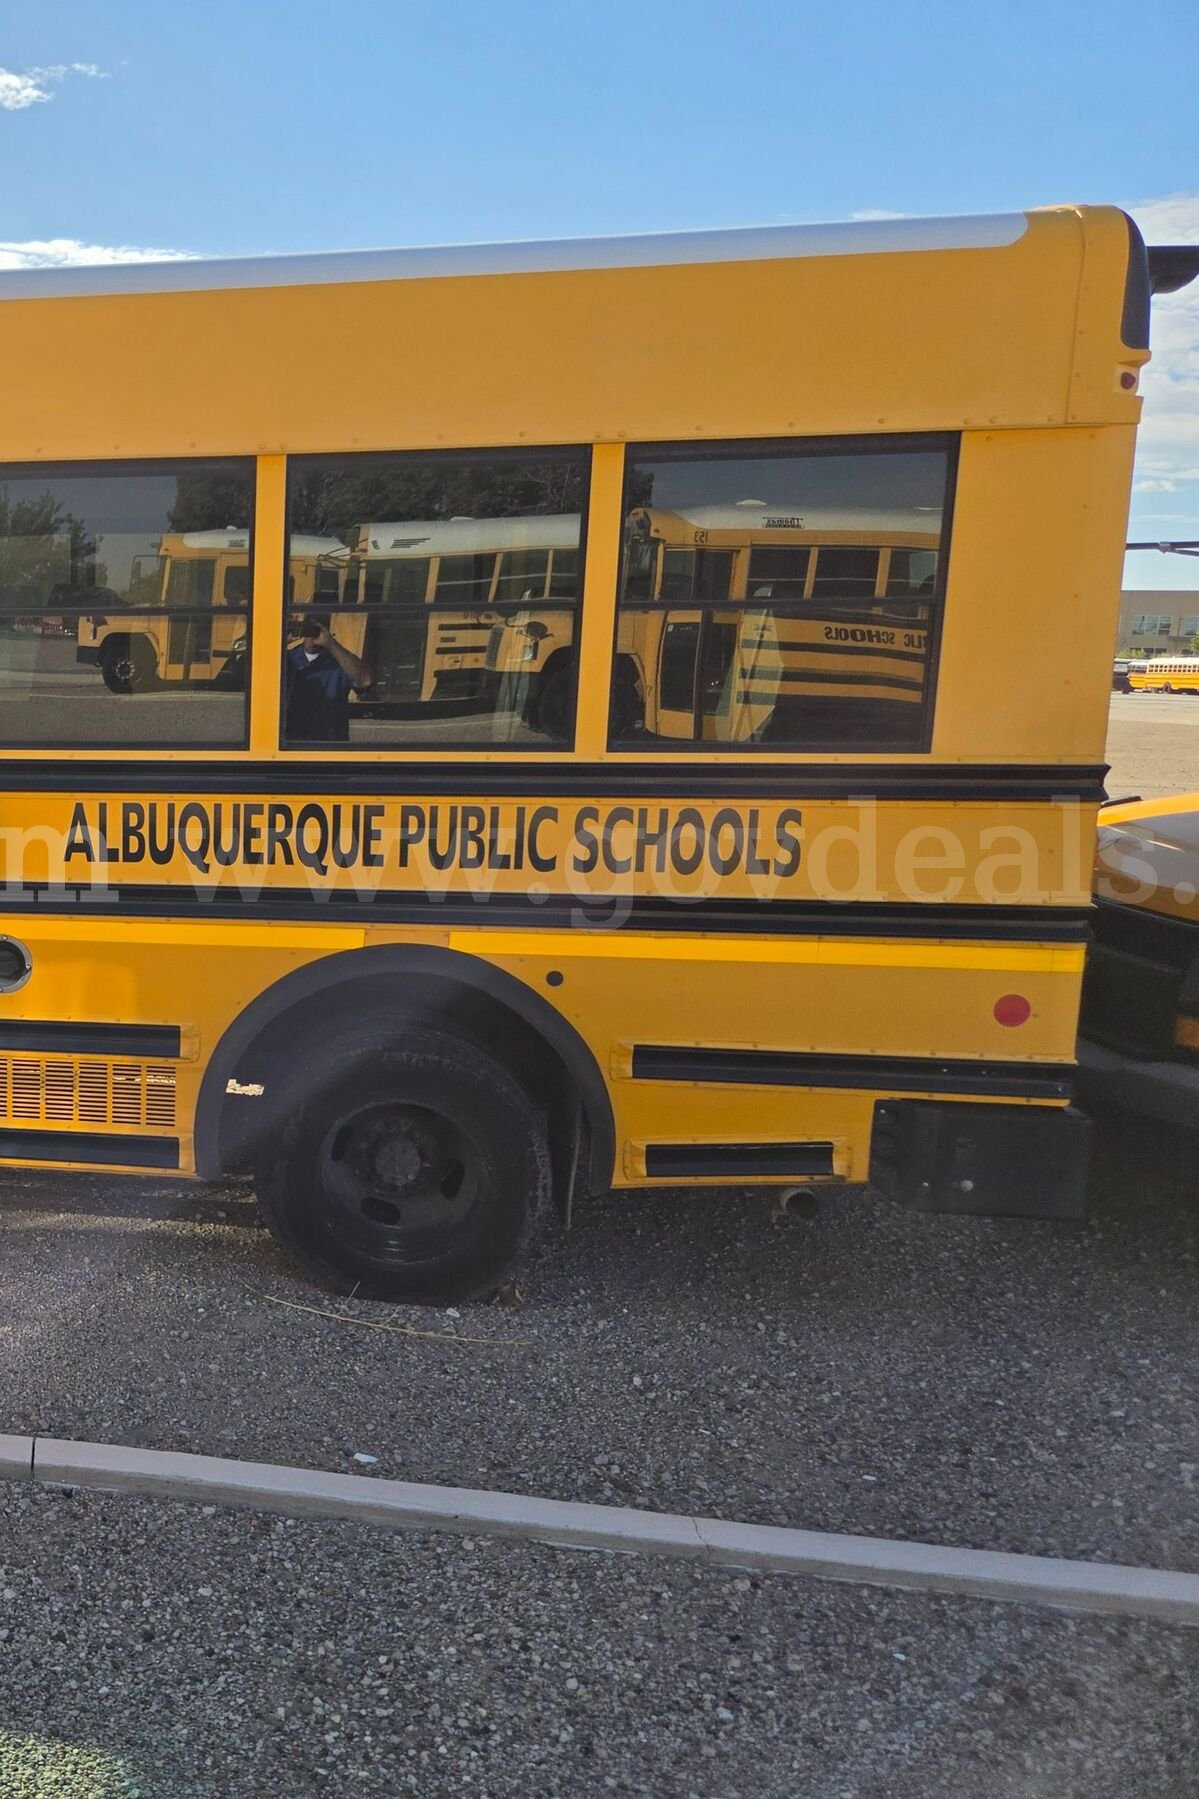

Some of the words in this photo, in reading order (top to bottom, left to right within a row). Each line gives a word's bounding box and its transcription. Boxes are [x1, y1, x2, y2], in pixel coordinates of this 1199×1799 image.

[64, 802, 383, 876] ALBUQUERQUE
[399, 804, 557, 872] PUBLIC
[572, 806, 803, 877] SCHOOLS
